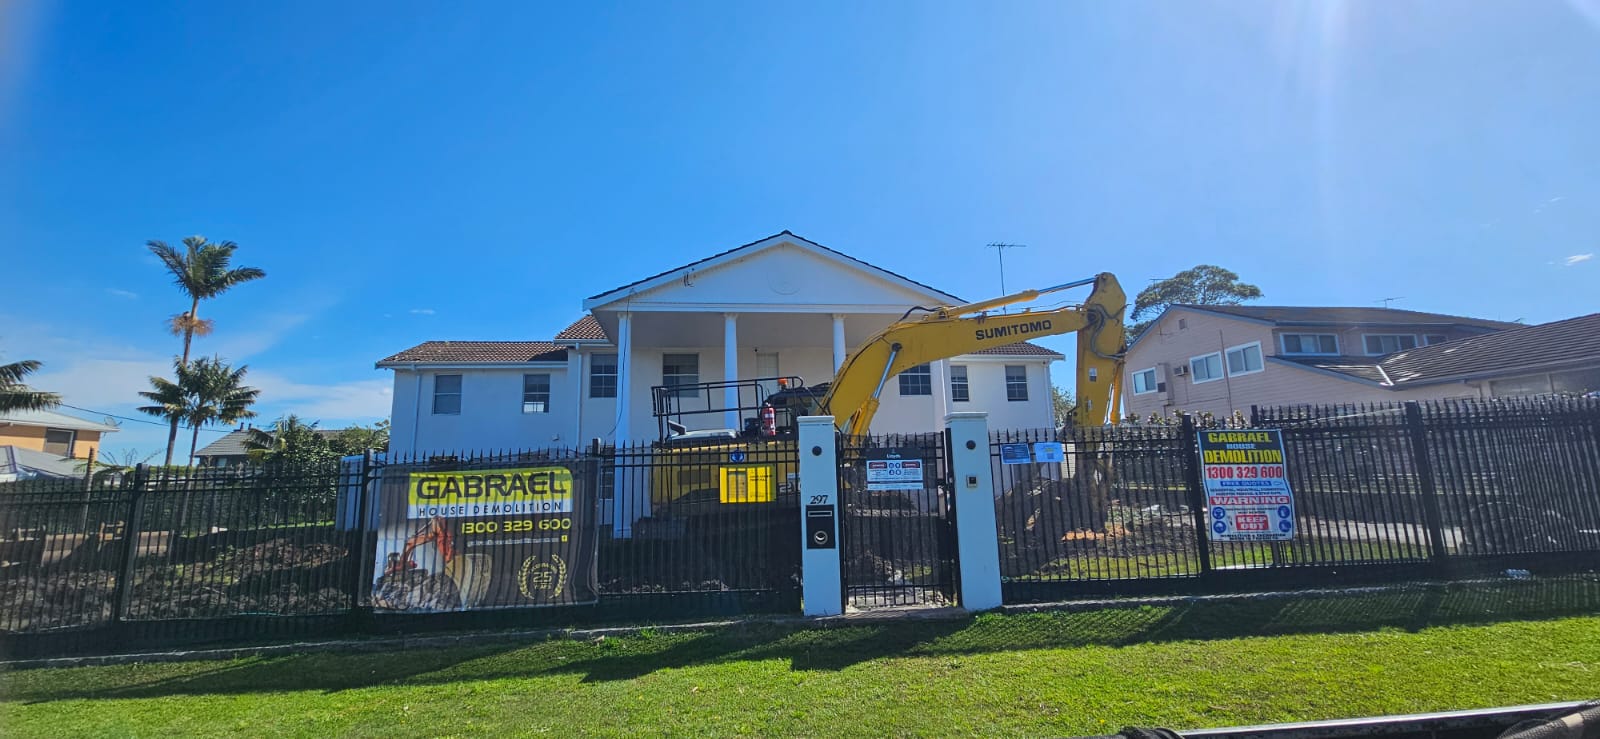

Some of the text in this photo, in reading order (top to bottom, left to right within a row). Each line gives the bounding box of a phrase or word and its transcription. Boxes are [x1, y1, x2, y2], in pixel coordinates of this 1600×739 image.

[975, 320, 1052, 341] SUMITOMO
[1207, 432, 1272, 443] GABRAEL
[1203, 449, 1282, 463] DEMOLITION
[1206, 466, 1283, 479] 1300 329 600
[416, 471, 567, 499] GABRAEL
[810, 494, 829, 505] 297
[1213, 496, 1288, 505] WARNING
[419, 502, 562, 517] HOUSE DEMOLITION
[461, 518, 572, 534] 1300 329 600
[533, 571, 552, 582] 25
